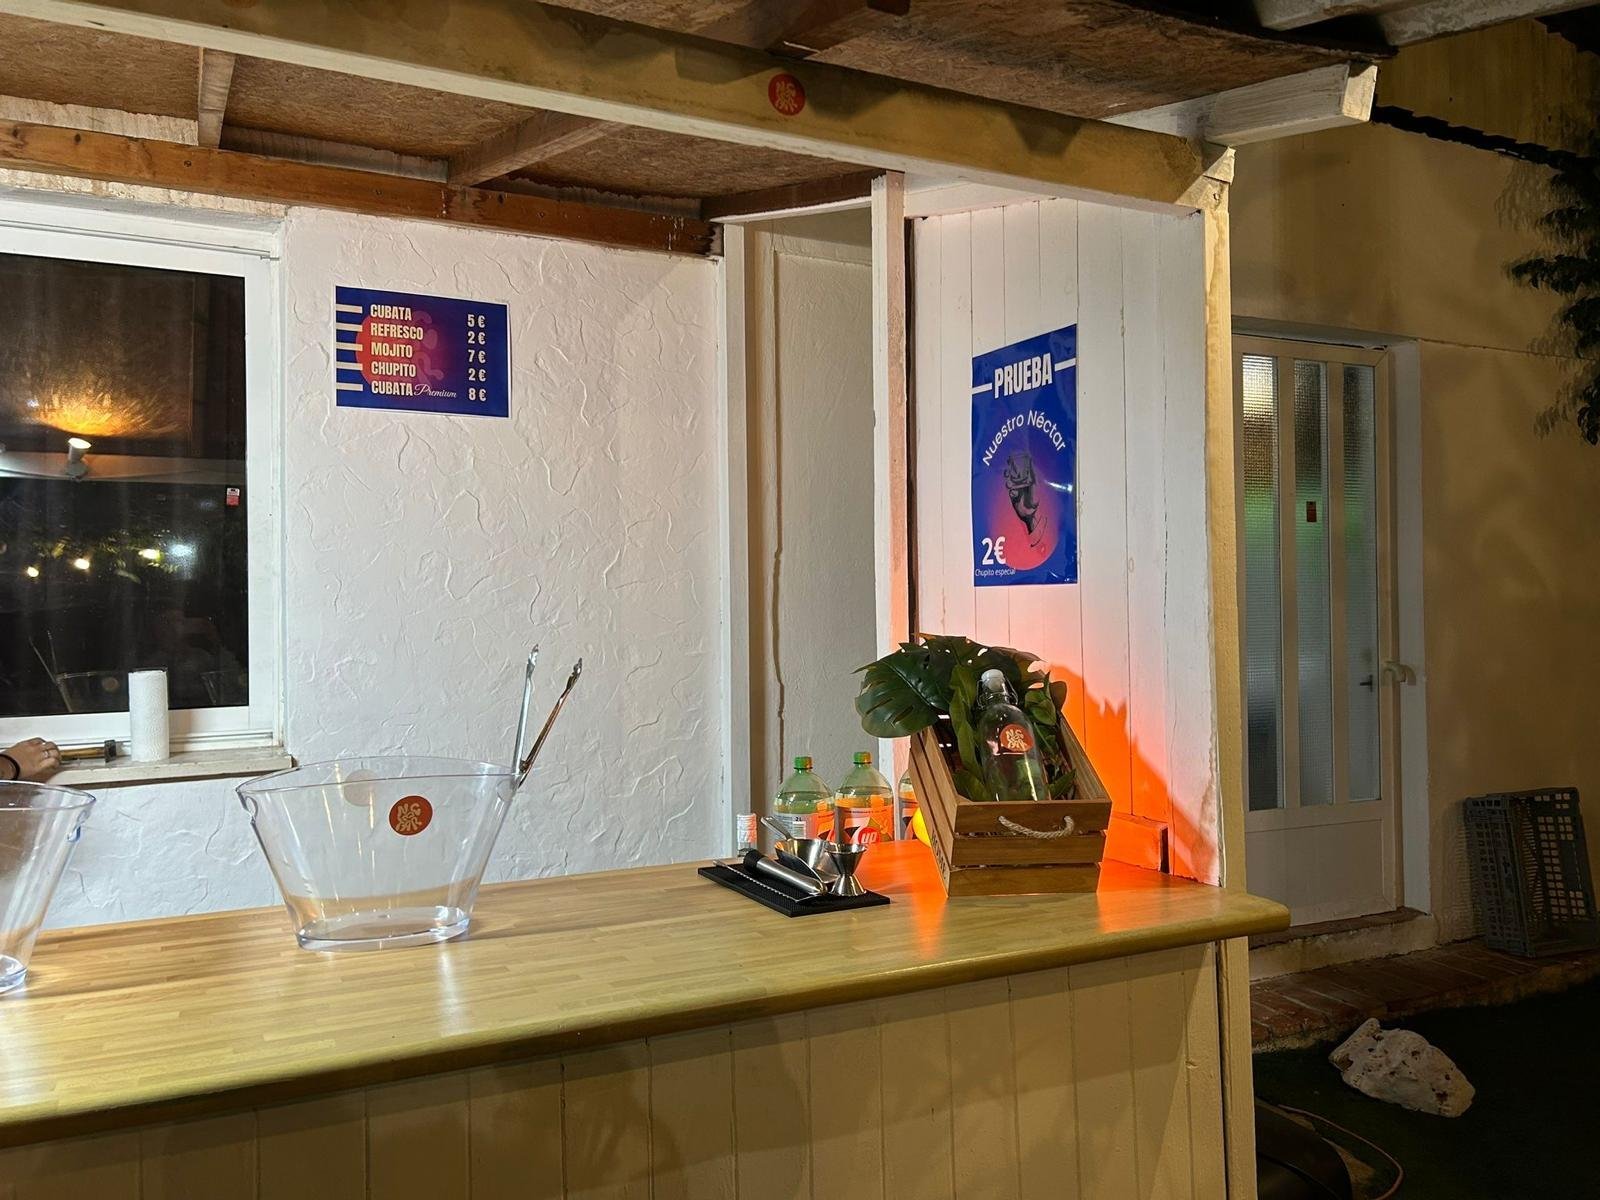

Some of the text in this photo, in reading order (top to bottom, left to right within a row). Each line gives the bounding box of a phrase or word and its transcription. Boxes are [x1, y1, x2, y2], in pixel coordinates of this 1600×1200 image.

[370, 304, 486, 328] CUBATA 5 €
[370, 323, 486, 345] REFRESCO 2 €
[371, 342, 486, 364] MOJITO 7 €
[371, 361, 486, 382] CHUPITO 2 €
[994, 352, 1053, 399] PRUEBA
[371, 380, 487, 401] CUBATA Premium 8 €
[982, 409, 1066, 466] Nuestro Néctar
[981, 536, 1006, 565] 2€
